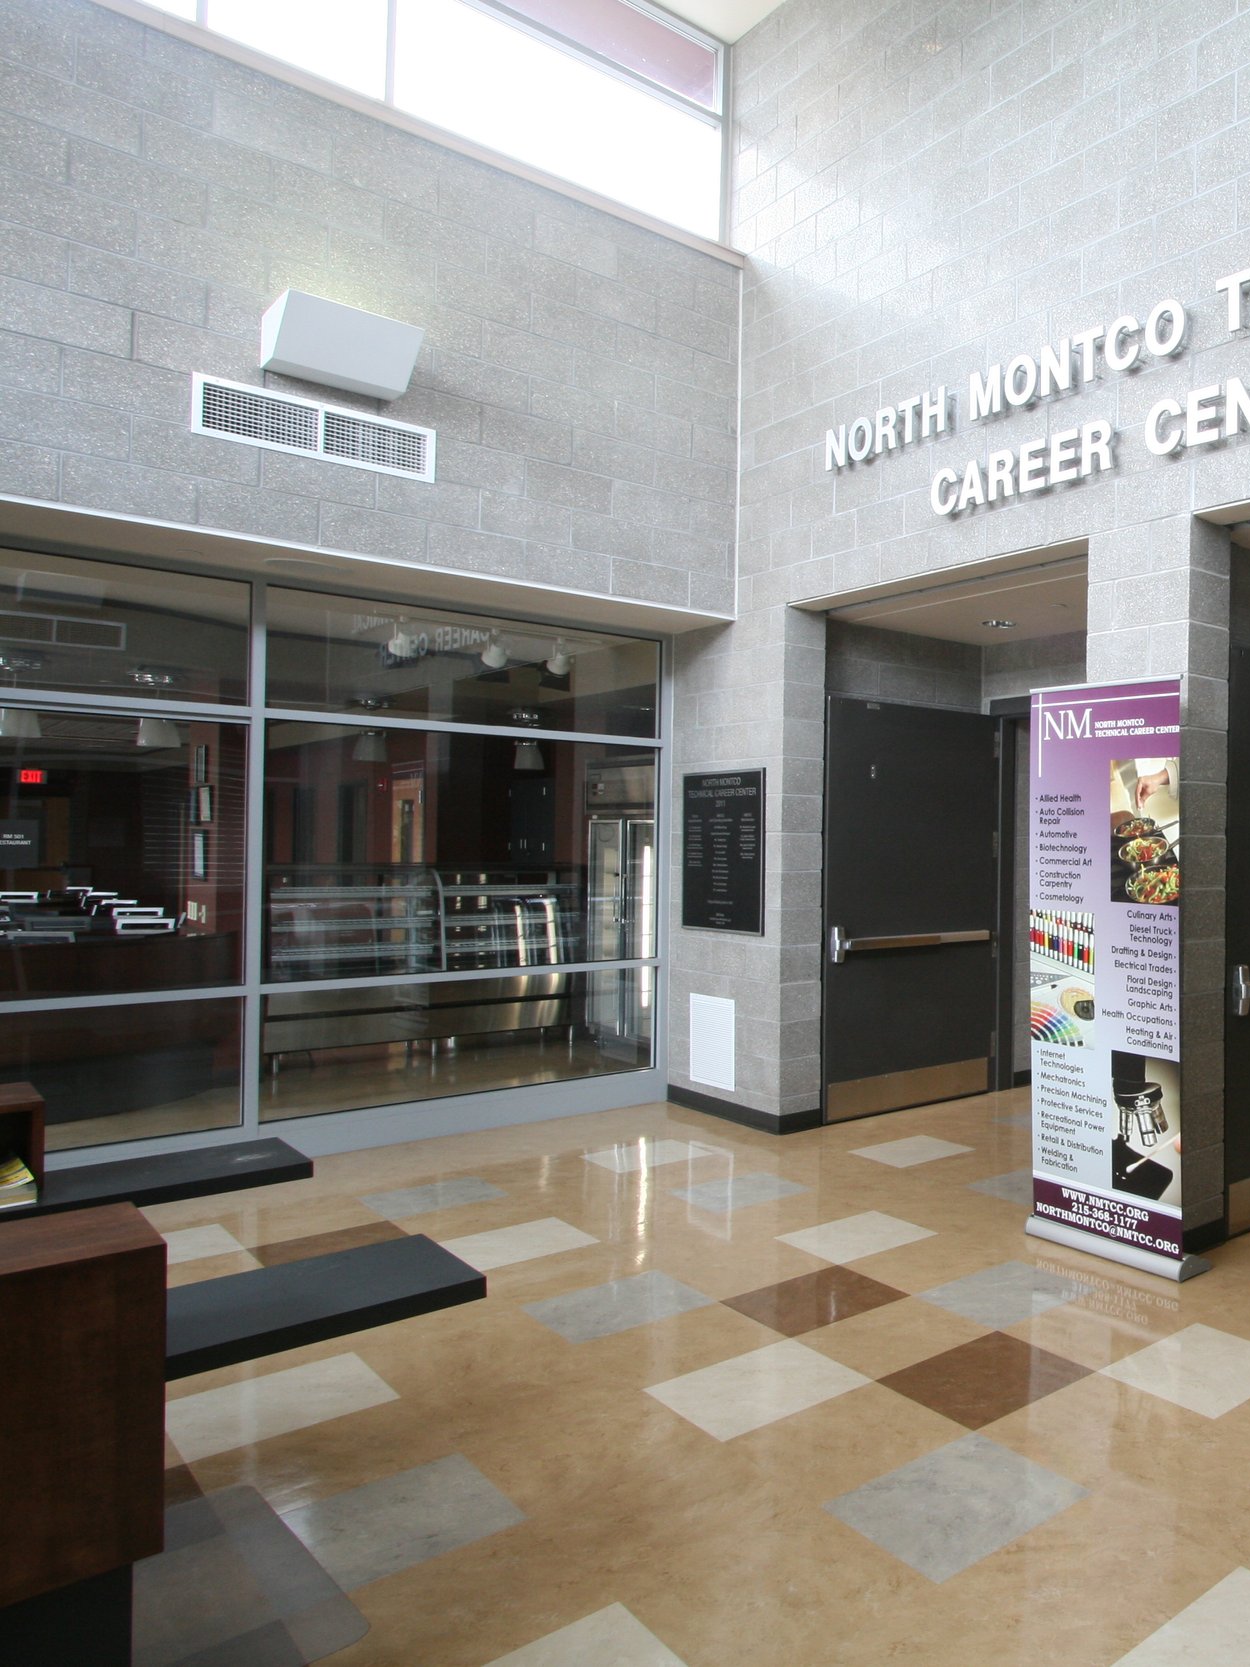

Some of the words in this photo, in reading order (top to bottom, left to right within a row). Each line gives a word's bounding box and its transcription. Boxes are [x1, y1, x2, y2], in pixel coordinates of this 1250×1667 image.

[825, 387, 948, 472] NORTH
[969, 299, 1186, 421] MONTCO
[930, 419, 1113, 515] CAREER
[1044, 708, 1093, 740] NM
[1095, 720, 1116, 729] NORTH
[1117, 718, 1145, 727] MONTCO
[1095, 728, 1129, 737] TECHNICAL
[1130, 727, 1154, 735] CAREER
[1156, 725, 1180, 734] CENTER
[20, 769, 44, 783] EXIT
[1039, 794, 1058, 803] Allied
[1060, 794, 1082, 803] Health
[1039, 808, 1055, 816] Auto
[1057, 808, 1085, 816] Collision
[1039, 817, 1061, 826] Repair
[1039, 831, 1078, 839] Automotive
[1039, 844, 1087, 854] Biotechnology
[1039, 858, 1081, 866] Commercial
[1082, 858, 1093, 866] Art
[1039, 871, 1081, 880] Construction
[1039, 879, 1073, 890] Carpentry
[1039, 892, 1084, 904] Cosmetology
[1127, 910, 1157, 922] Culinary
[1159, 913, 1173, 921] Arts
[1130, 925, 1151, 934] Diesel
[1153, 926, 1173, 935] Truck
[1130, 934, 1173, 947] Technology
[1111, 946, 1139, 958] Drafting
[1140, 949, 1146, 957] &
[1148, 949, 1173, 961] Design
[1114, 960, 1147, 971] Electrical
[1149, 963, 1173, 974] Trades
[1127, 975, 1146, 985] Floral
[1148, 977, 1173, 989] Design
[1126, 985, 1173, 999] Landscaping
[1127, 998, 1157, 1011] Graphic
[1159, 1003, 1173, 1012] Arts
[1101, 1009, 1125, 1020] Health
[1126, 1012, 1173, 1027] Occupations
[1126, 1026, 1154, 1039] Heating
[1156, 1031, 1162, 1039] &
[1163, 1031, 1173, 1040] Air
[1127, 1037, 1173, 1053] Conditioning
[1040, 1049, 1066, 1060] Internet
[1040, 1059, 1084, 1074] Technologies
[1040, 1072, 1086, 1088] Mechatronics
[1041, 1085, 1069, 1099] Precision
[1071, 1091, 1108, 1107] Machining
[1041, 1098, 1073, 1111] Protective
[1074, 1104, 1104, 1119] Services
[1041, 1111, 1083, 1128] Recreational
[1084, 1120, 1106, 1133] Power
[1041, 1121, 1076, 1136] Equipment
[1041, 1133, 1060, 1146] Retail
[1060, 1138, 1065, 1147] &
[1067, 1139, 1104, 1156] Distribution
[1041, 1146, 1068, 1161] Welding
[1069, 1153, 1074, 1162] &
[1041, 1156, 1078, 1173] Fabrication
[1061, 1188, 1149, 1221] WWW.NMTCC.ORG
[1071, 1202, 1138, 1230] 215-368-1177
[1036, 1201, 1180, 1255] NORTHMONTCO@NMTCC.ORG
